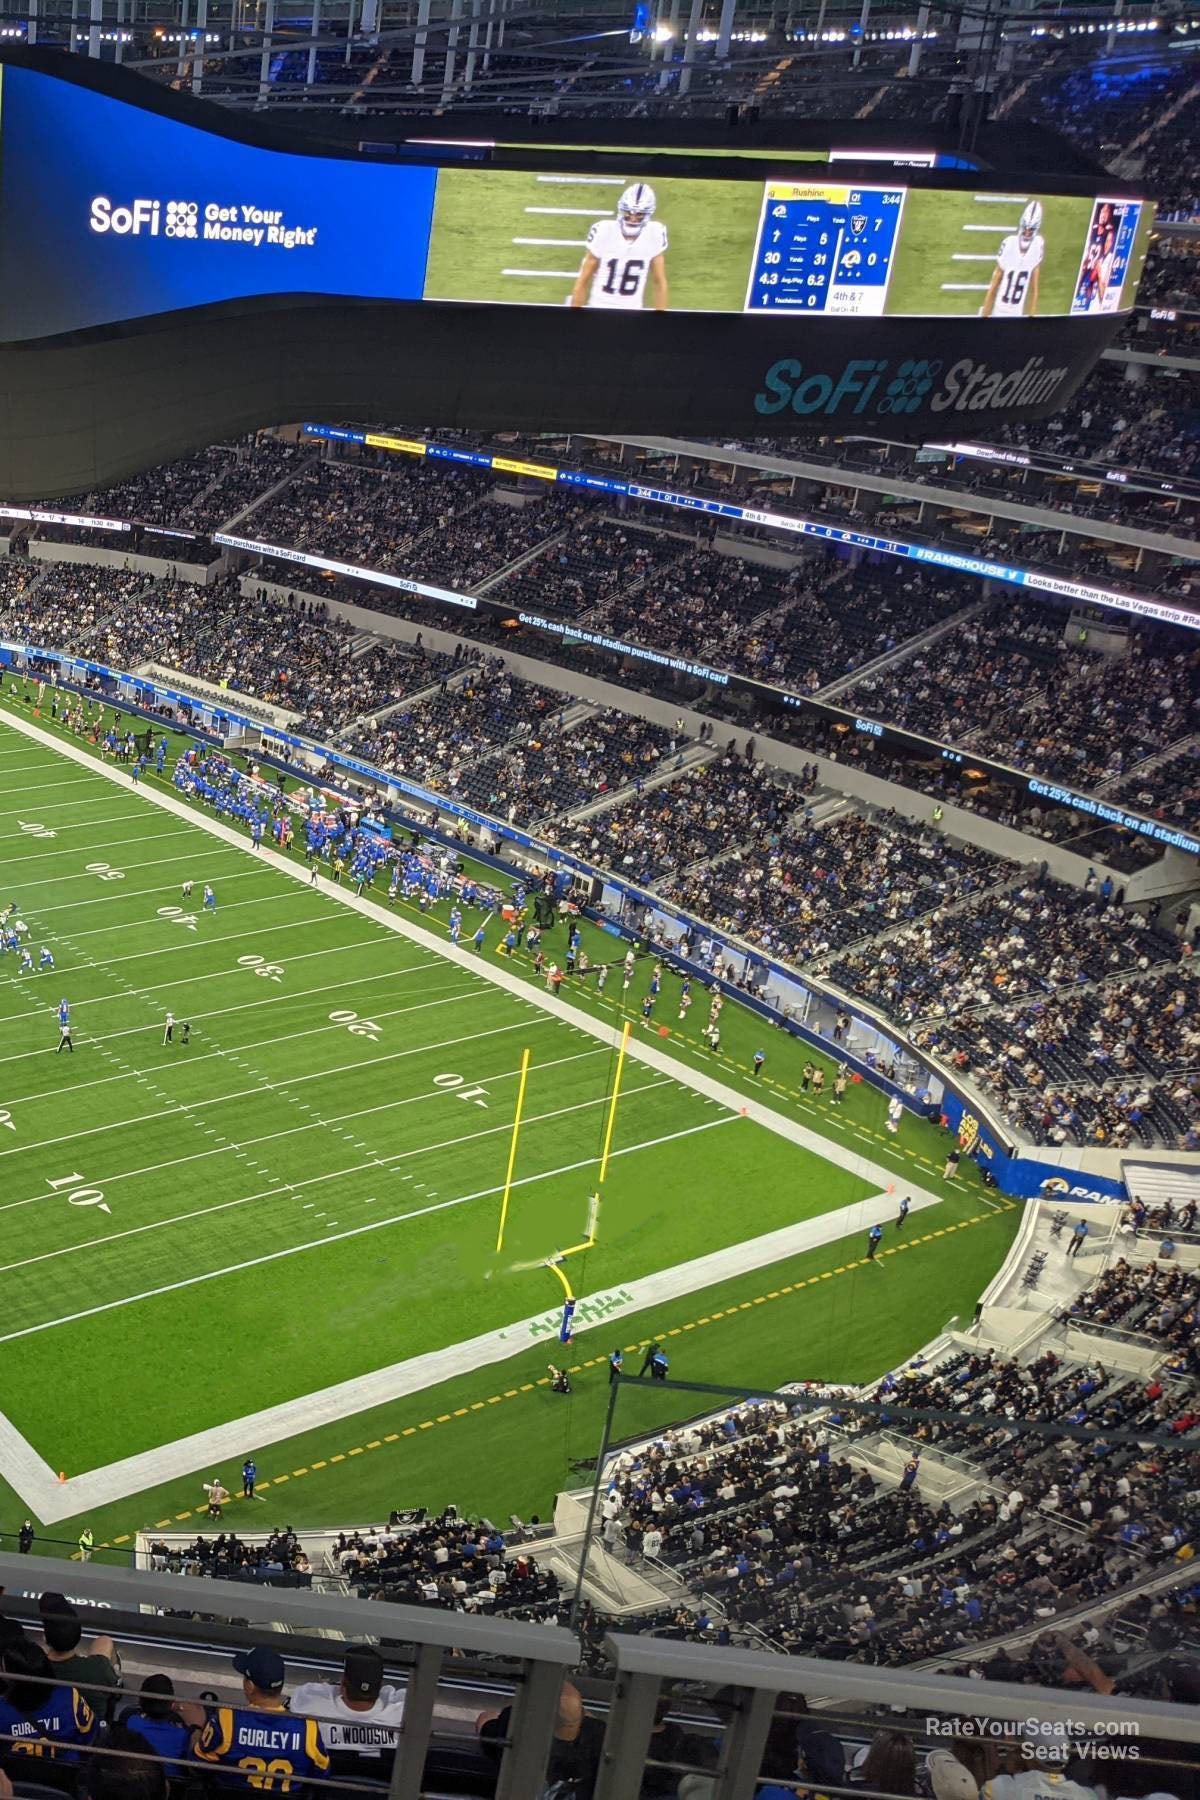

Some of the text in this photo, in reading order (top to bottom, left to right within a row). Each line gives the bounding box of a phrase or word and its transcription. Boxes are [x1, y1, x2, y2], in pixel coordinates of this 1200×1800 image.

[882, 195, 900, 205] 3:44
[90, 196, 160, 236] SoFi
[204, 203, 283, 225] Get Your
[874, 218, 883, 232] 7
[203, 222, 317, 249] Money Right
[764, 252, 827, 266] 30 31
[867, 253, 877, 266] 0
[601, 258, 644, 296] 16
[759, 272, 825, 287] 4.3 6.2
[1000, 271, 1028, 305] 16
[762, 293, 817, 307] 1 0
[754, 356, 1069, 415] SoFi Stadium
[233, 540, 262, 552] purchases
[262, 545, 275, 554] with
[279, 550, 292, 558] SoFi
[292, 554, 306, 562] card
[917, 548, 1006, 577] #RAMSHOUSE
[1027, 576, 1051, 589] Looks
[1053, 582, 1079, 595] better
[1080, 588, 1099, 600] than
[1100, 593, 1114, 604] the
[1115, 597, 1130, 608] Las
[1131, 601, 1159, 615] Vegas
[1160, 608, 1181, 622] strip
[518, 613, 532, 624] Get
[532, 617, 547, 628] 25%
[547, 623, 564, 633] cash
[565, 625, 582, 639] back
[582, 633, 592, 642] on
[592, 634, 602, 644] all
[602, 639, 631, 654] stadium
[631, 648, 669, 666] purchases
[669, 658, 687, 670] with
[692, 666, 709, 679] SoFi
[709, 673, 728, 684] card
[855, 719, 873, 734] SoFi
[1028, 780, 1200, 853] Get 25% cash back on all stadium
[21, 823, 58, 838] 40
[85, 863, 125, 881] 50
[156, 906, 199, 924] 40
[237, 955, 285, 977] 30
[328, 1010, 383, 1036] 20
[433, 1073, 491, 1101] 10
[45, 1172, 104, 1206] 10
[1069, 1186, 1131, 1206] RAM
[238, 1727, 286, 1750] GURLEY
[291, 1732, 300, 1750] II
[330, 1726, 341, 1745] C.
